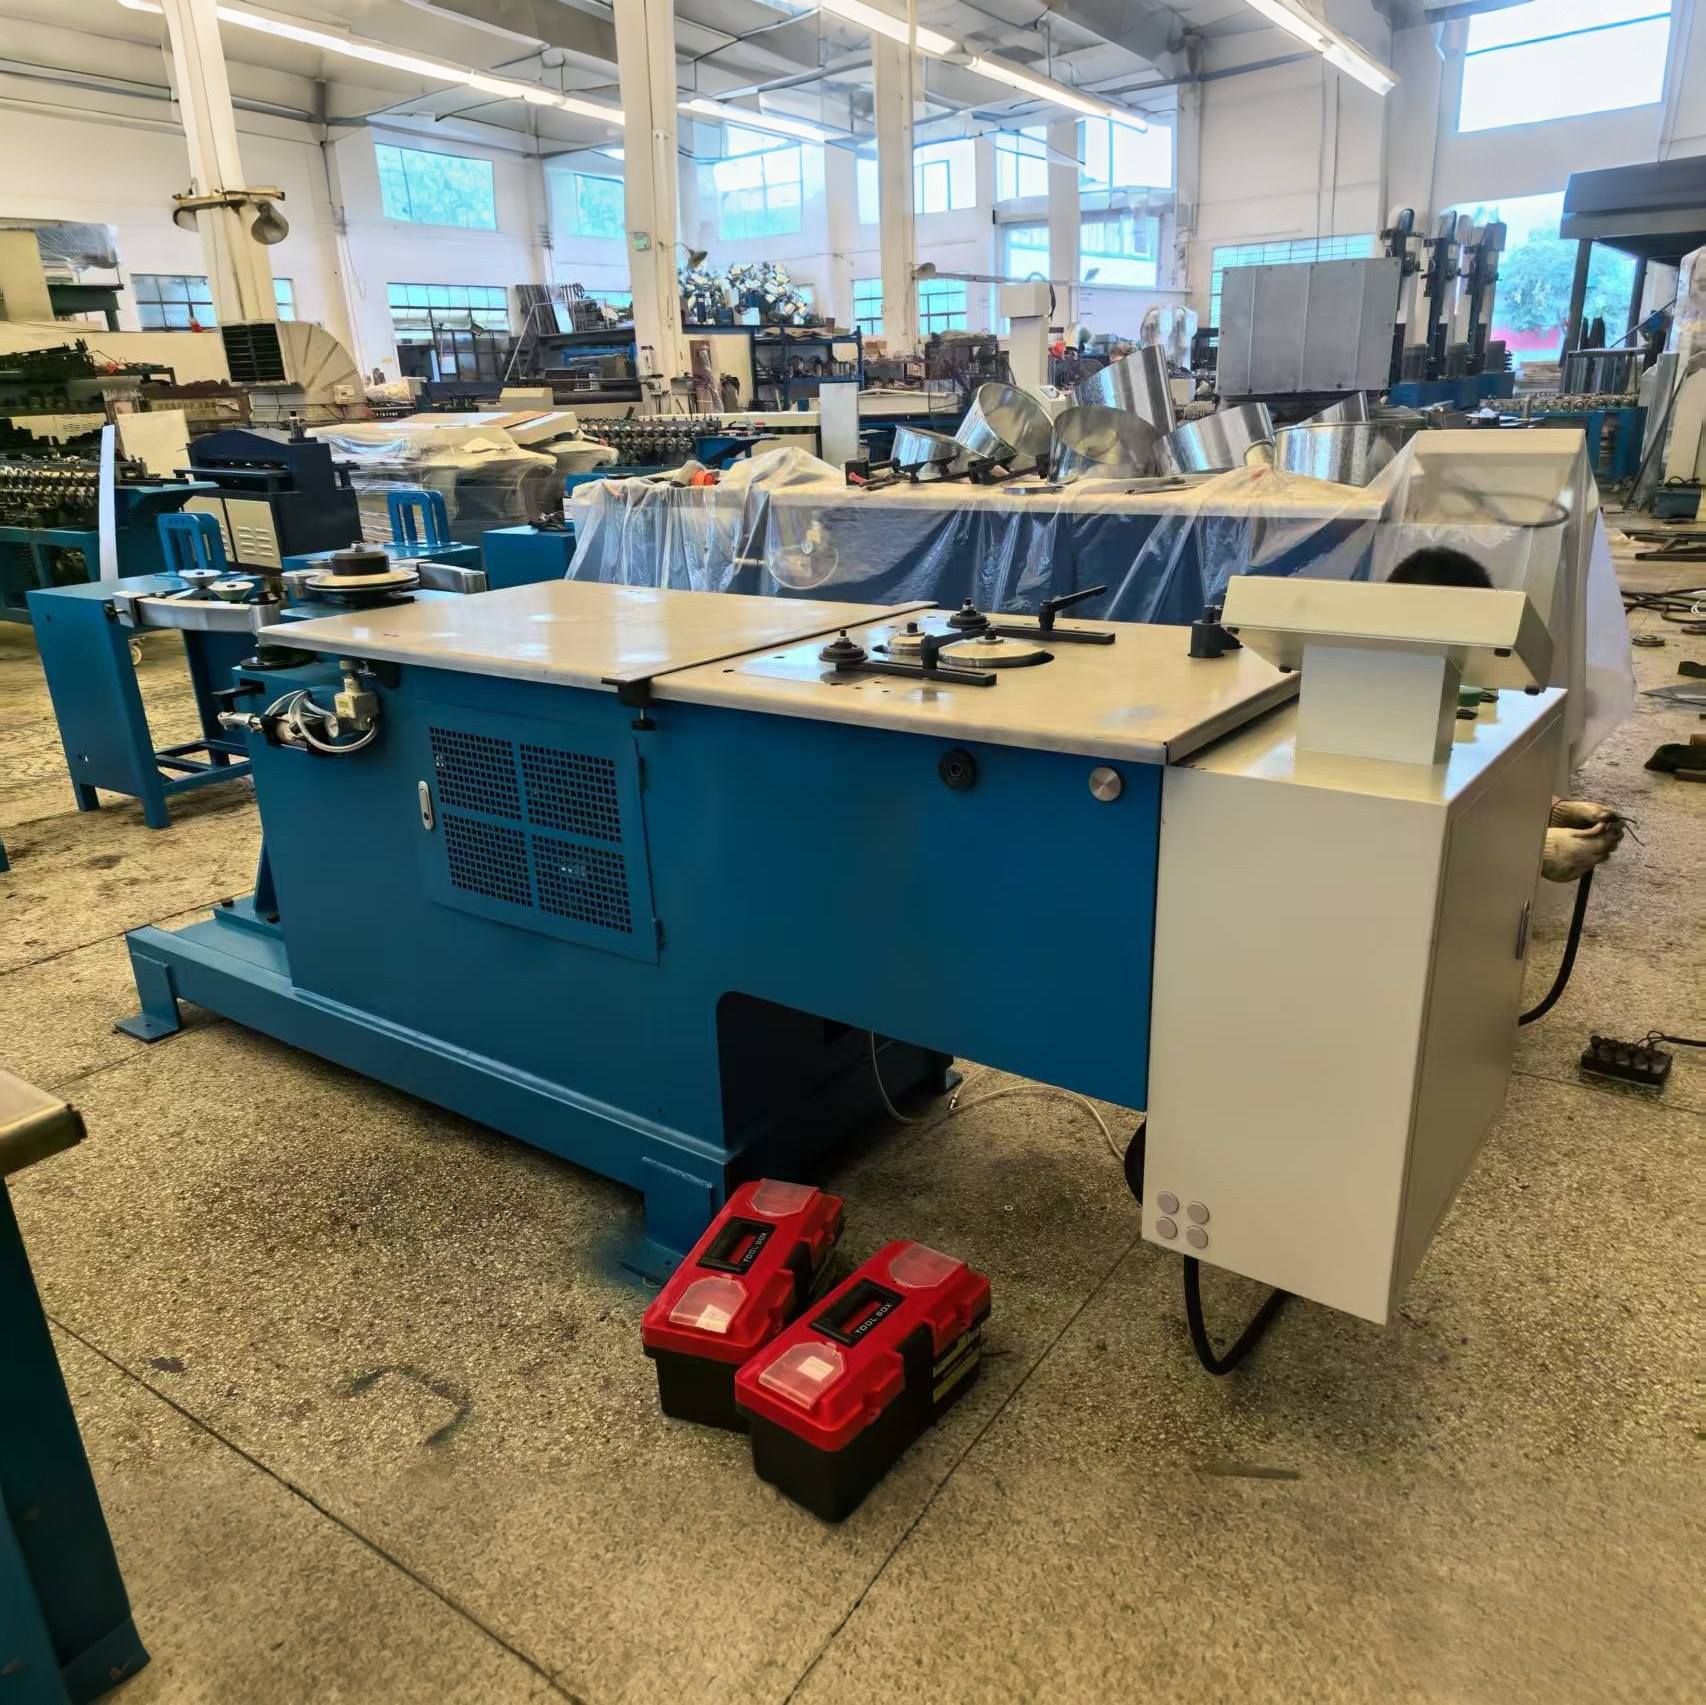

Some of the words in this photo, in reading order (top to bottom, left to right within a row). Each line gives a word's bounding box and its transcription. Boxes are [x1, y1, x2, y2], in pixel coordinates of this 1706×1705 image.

[743, 1245, 759, 1262] TOOL
[854, 1317, 878, 1334] TOOL
[875, 1303, 893, 1317] BOX
